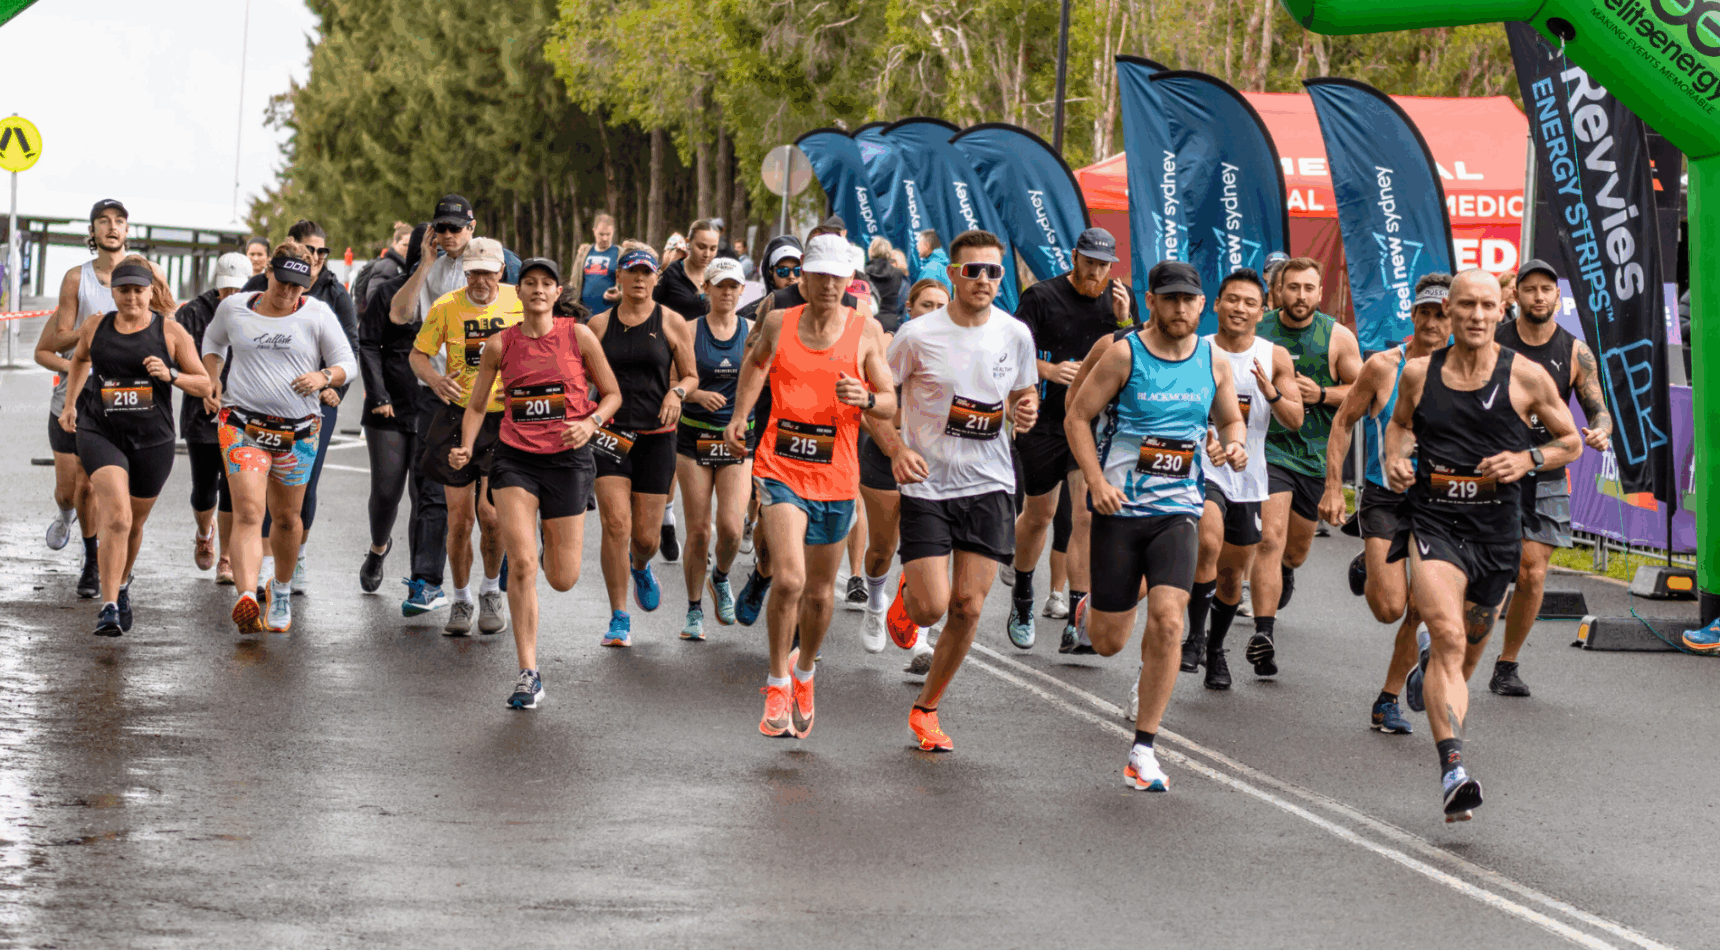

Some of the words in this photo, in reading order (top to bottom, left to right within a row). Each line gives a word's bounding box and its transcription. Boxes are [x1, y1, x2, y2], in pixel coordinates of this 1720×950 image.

[1590, 8, 1627, 41] MAKING
[1625, 37, 1661, 69] EVENTS
[1658, 65, 1716, 115] MEMORABLE
[1532, 77, 1582, 196] ENERGY
[1160, 150, 1180, 216] sydney
[1219, 162, 1243, 231] sydney
[1375, 166, 1402, 234] sydney
[1560, 66, 1644, 301] Revvies
[854, 186, 878, 235] sydney
[903, 179, 922, 231] sydney
[1027, 189, 1058, 245] sydney
[1164, 219, 1178, 261] new
[1227, 233, 1242, 274] new
[1388, 236, 1407, 280] new
[1392, 281, 1412, 321] feel
[114, 391, 138, 406] 218
[525, 399, 551, 416] 201
[1137, 392, 1202, 402] BLACKMORES
[256, 431, 282, 447] 225
[596, 432, 619, 451] 212
[965, 414, 990, 431] 211
[790, 436, 818, 456] 215
[1151, 453, 1183, 473] 230
[1448, 480, 1478, 498] 219
